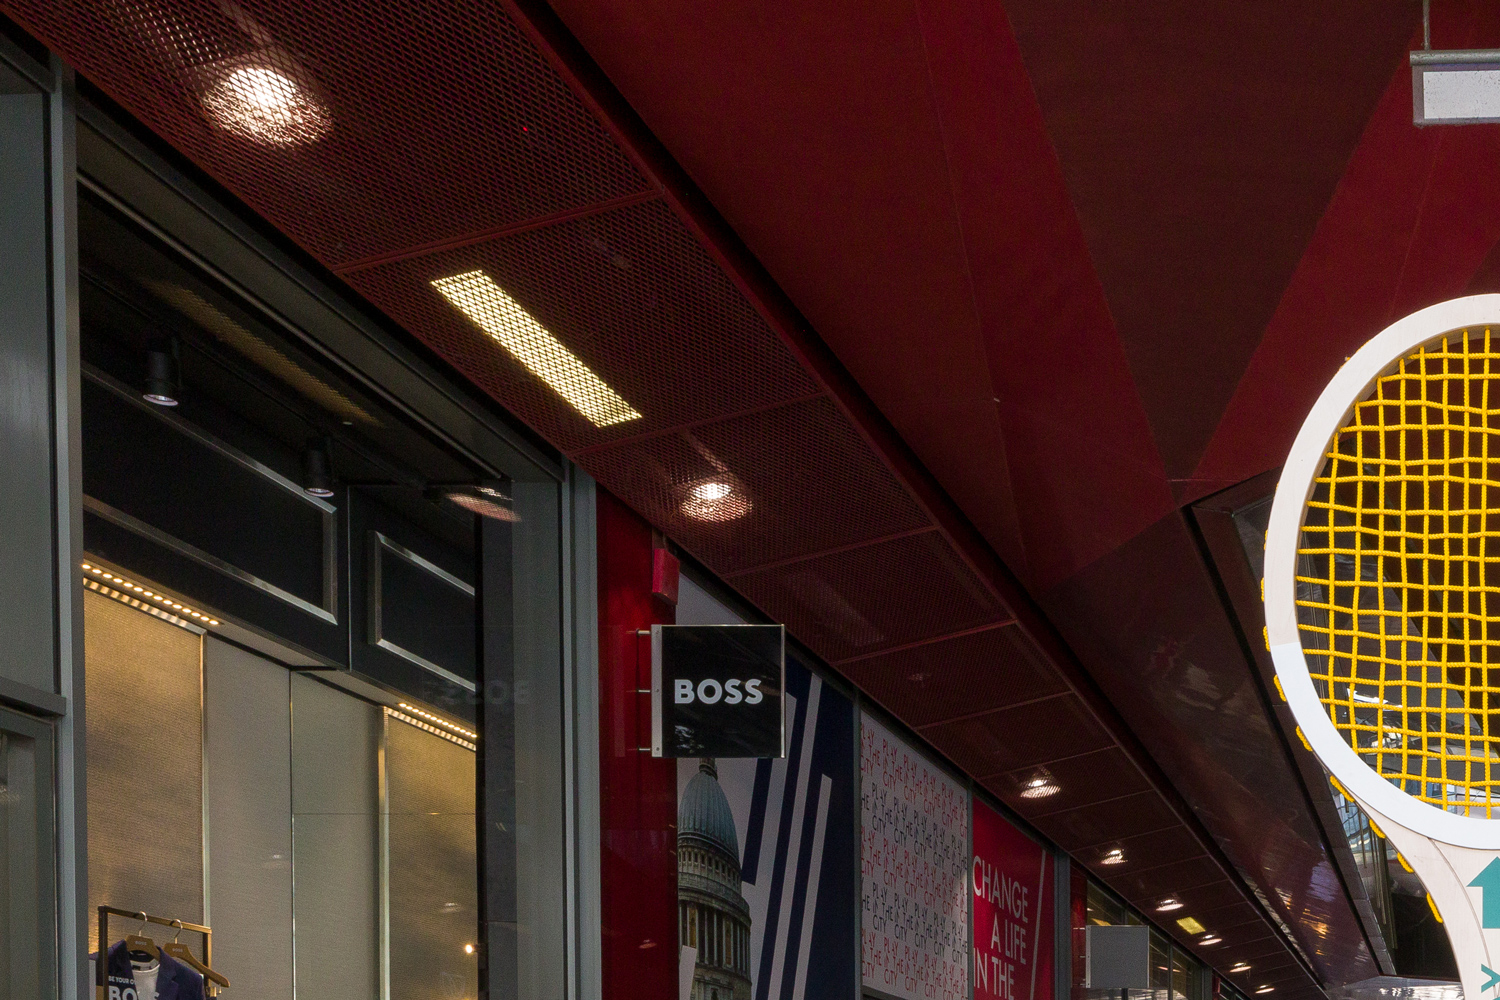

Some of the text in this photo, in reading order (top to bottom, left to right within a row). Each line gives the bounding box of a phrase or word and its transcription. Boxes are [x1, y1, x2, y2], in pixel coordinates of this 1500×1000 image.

[674, 678, 763, 705] BOSS
[972, 856, 1028, 923] CHANGE
[991, 912, 1026, 965] A LIFE
[115, 976, 129, 984] YOUR
[973, 947, 988, 993] IN
